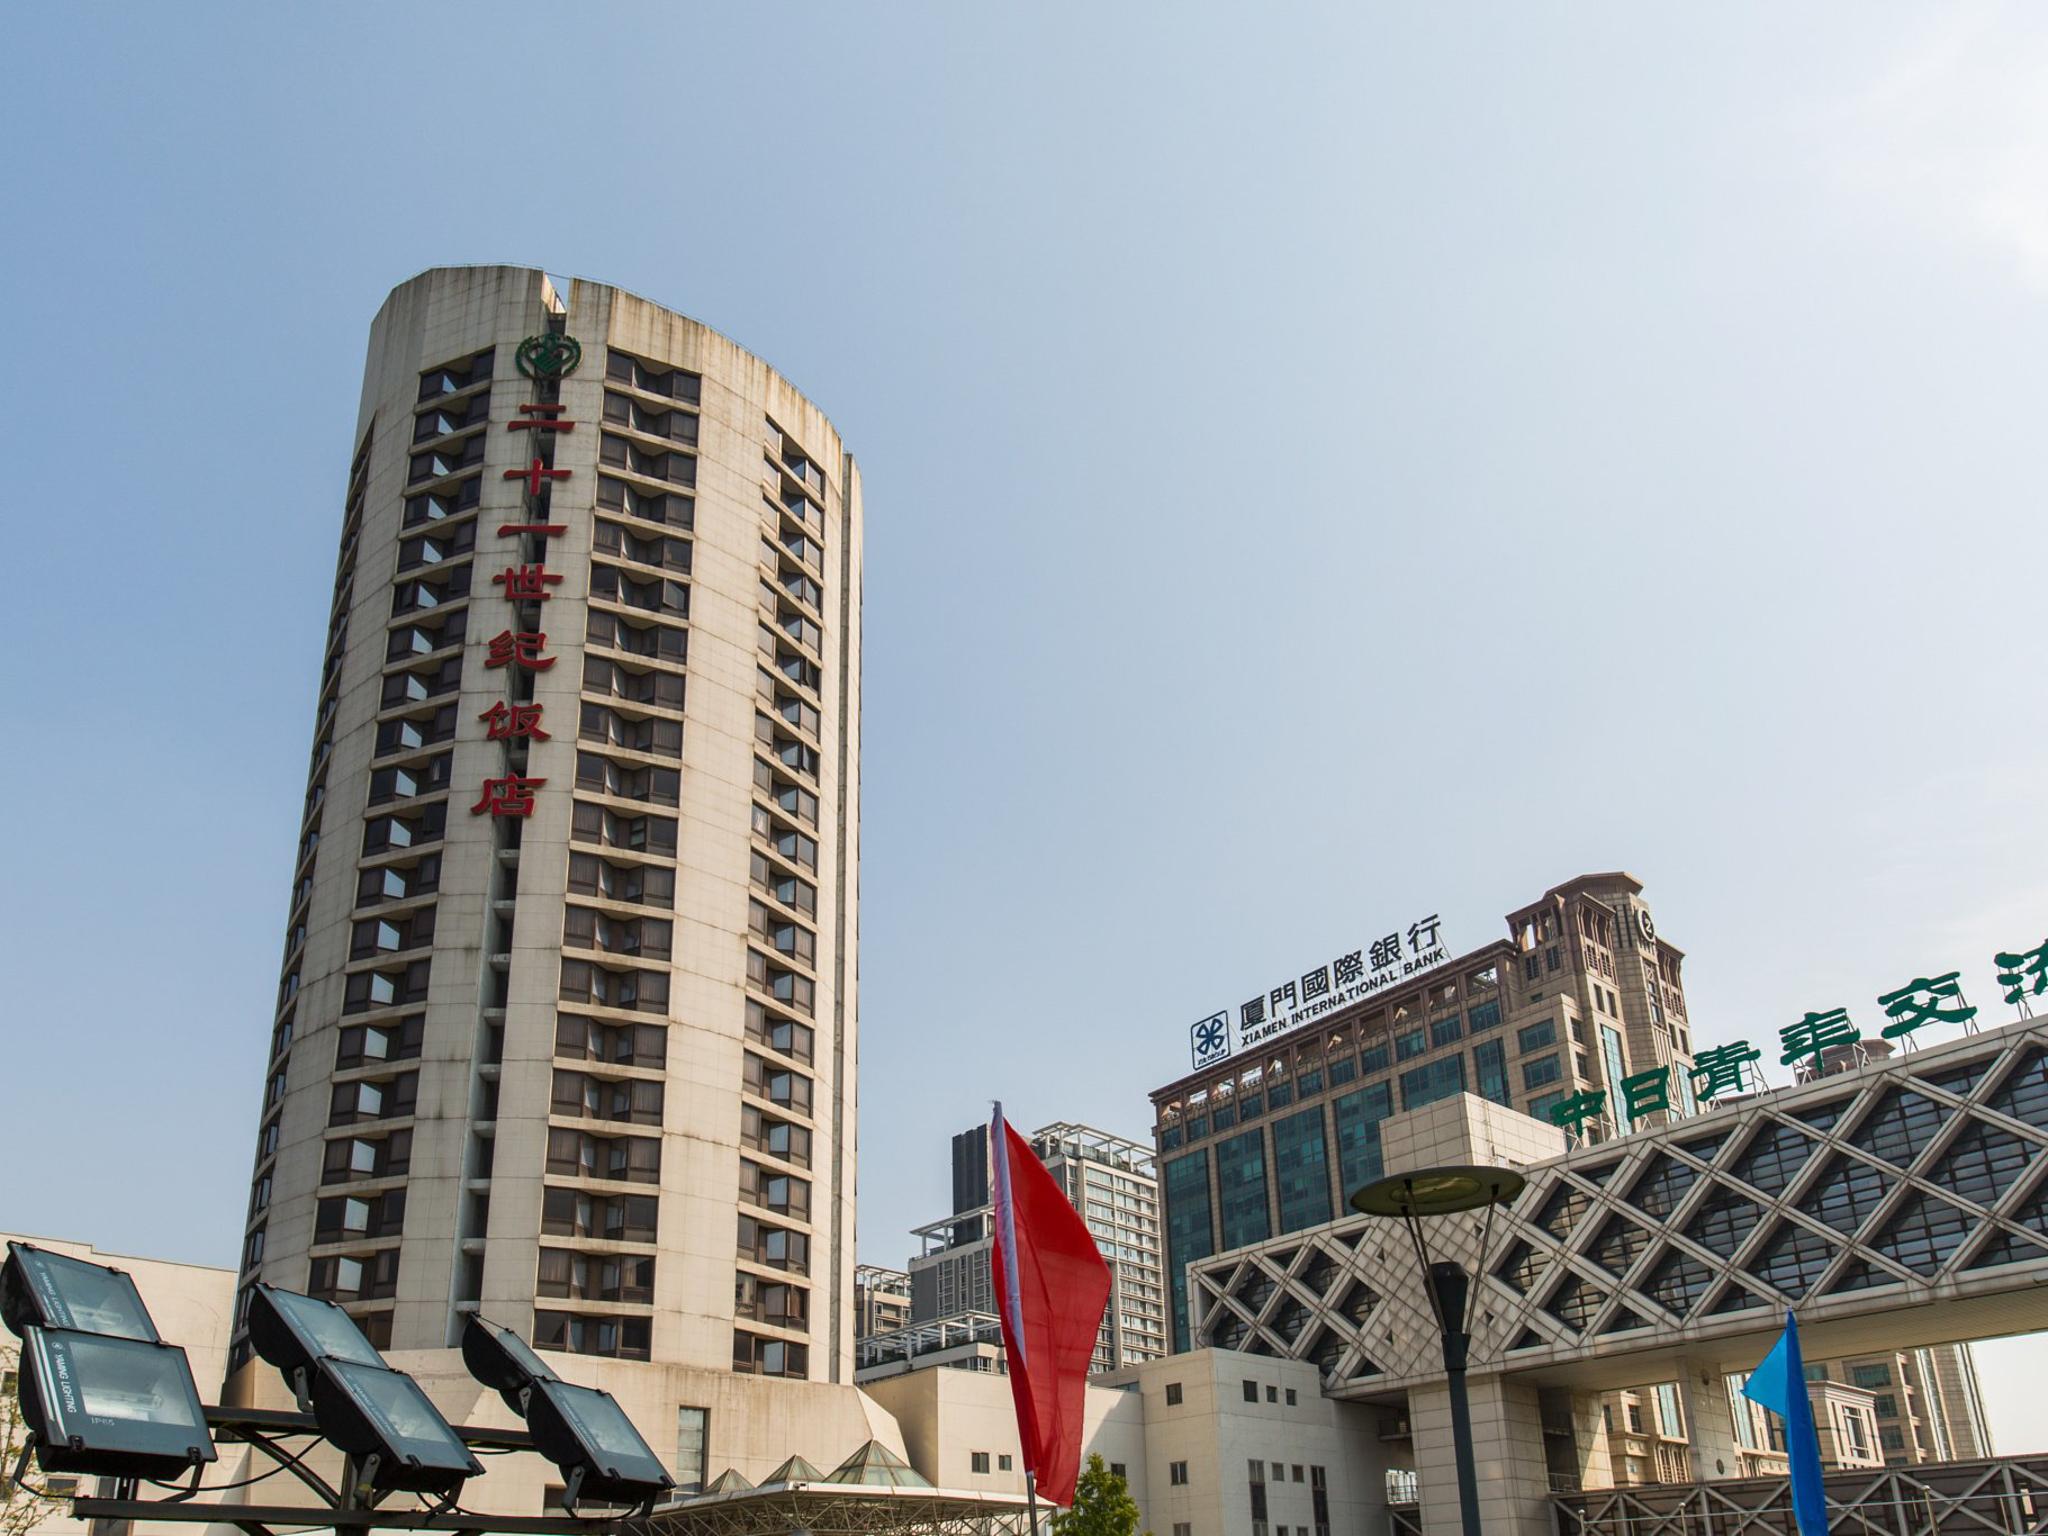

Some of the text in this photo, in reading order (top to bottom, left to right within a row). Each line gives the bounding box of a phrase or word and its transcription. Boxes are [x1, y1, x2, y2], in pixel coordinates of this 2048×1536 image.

[469, 403, 576, 817] 二十一世纪饭店
[1242, 947, 1445, 1047] XIAMEN INTERNATIONAL BANK
[55, 1354, 77, 1413] YAMING LIGHTING
